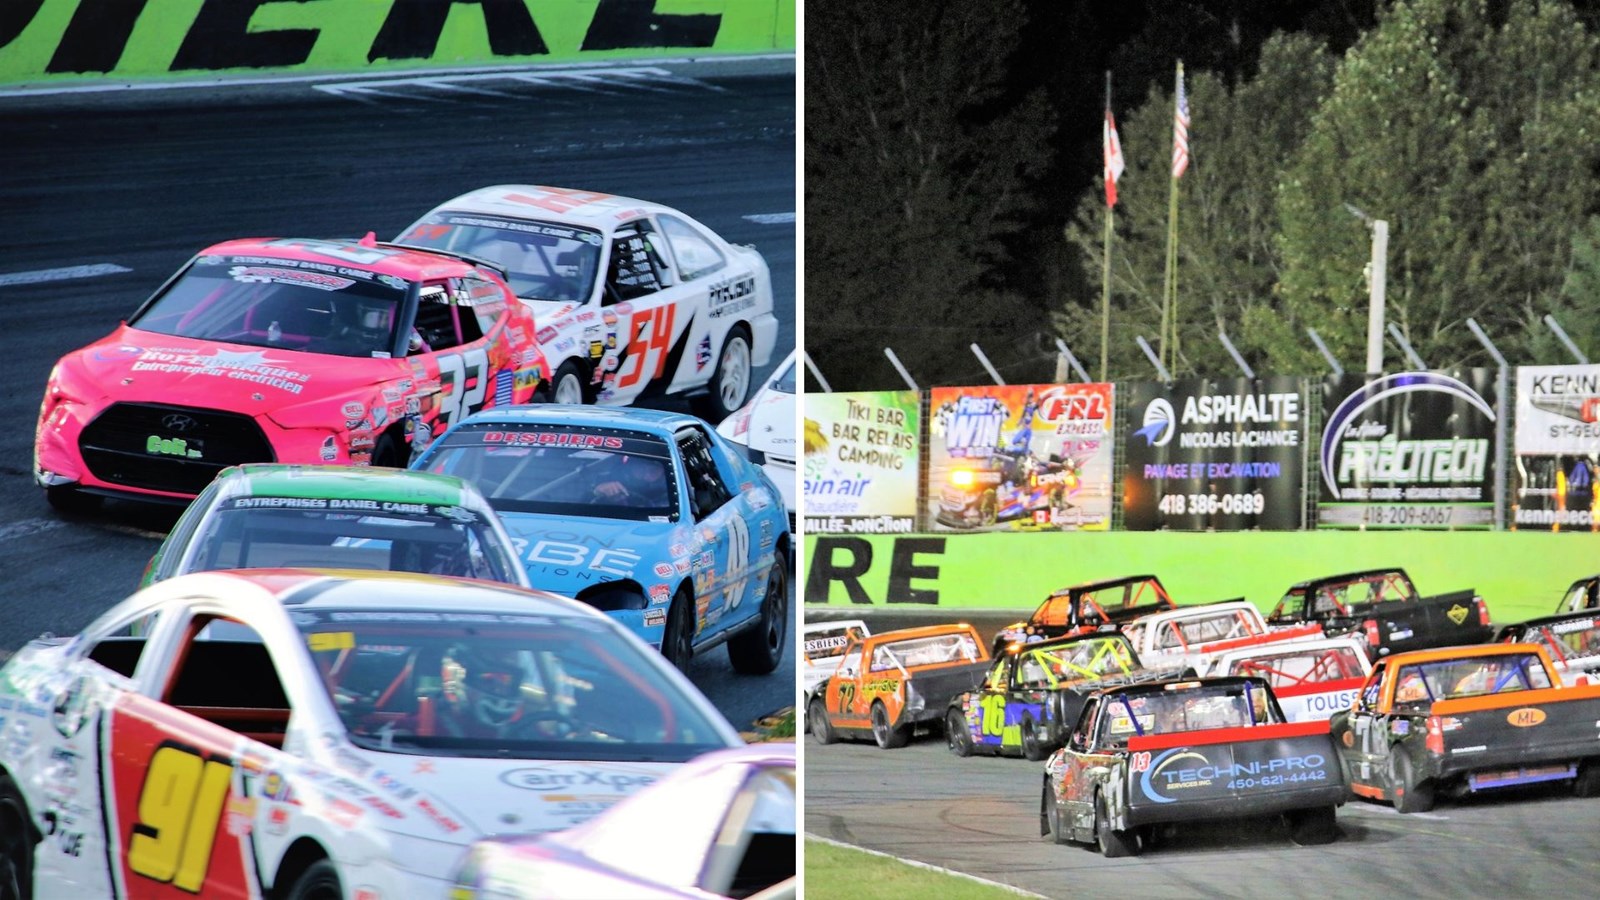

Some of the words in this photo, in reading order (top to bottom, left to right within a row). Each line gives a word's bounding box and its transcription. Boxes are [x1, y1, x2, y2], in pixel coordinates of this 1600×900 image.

[618, 302, 677, 389] 54
[131, 361, 227, 377] Entrepreneur
[876, 404, 904, 427] BAR
[960, 396, 997, 414] FIRST
[1048, 397, 1105, 420] FRL
[1181, 392, 1299, 424] ASPHALTE
[483, 431, 622, 449] DESBIENS
[832, 422, 862, 442] BAR
[867, 428, 913, 451] RELAIS
[946, 413, 1002, 448] WIN
[1180, 432, 1231, 448] NICOLAS
[1232, 430, 1298, 447] LACHANCE
[838, 444, 904, 471] CAMPING
[1338, 433, 1489, 482] PRÉCITECH
[1144, 464, 1188, 479] PAVAGE
[1191, 464, 1206, 478] ET
[1208, 462, 1280, 478] EXCAVATION
[837, 471, 871, 497] air
[234, 497, 327, 508] ENTREPRISES
[330, 499, 380, 510] DANIEL
[383, 502, 428, 514] CARRÉ
[1159, 494, 1186, 515] 418
[1188, 493, 1265, 515] 386-0689
[1363, 506, 1453, 524] 418-209-6067
[656, 564, 673, 575] BELL
[804, 536, 947, 604] RE
[980, 694, 1006, 736] 16
[1516, 711, 1538, 724] ML
[1133, 751, 1151, 772] 13
[1162, 754, 1325, 781] TECHNI-PRO
[1227, 769, 1326, 790] 450-621-4442
[128, 740, 235, 893] 91
